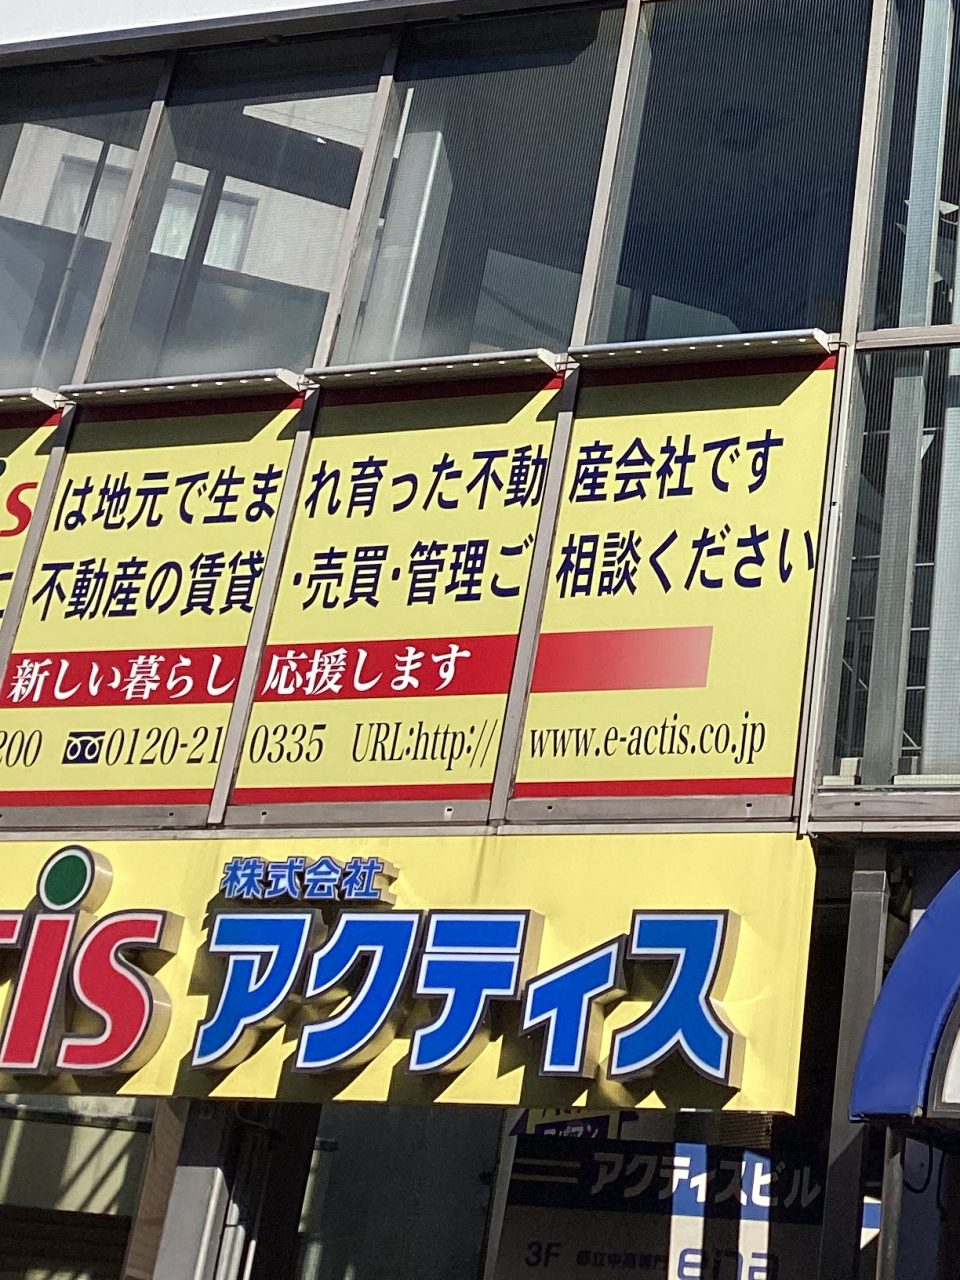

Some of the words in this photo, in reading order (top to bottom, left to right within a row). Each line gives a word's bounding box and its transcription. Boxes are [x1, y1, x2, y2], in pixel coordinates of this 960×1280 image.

[221, 856, 386, 901] 株式会社
[190, 908, 737, 1089] アクティス
[590, 1151, 822, 1209] アクティスビル
[524, 1240, 562, 1269] 3F
